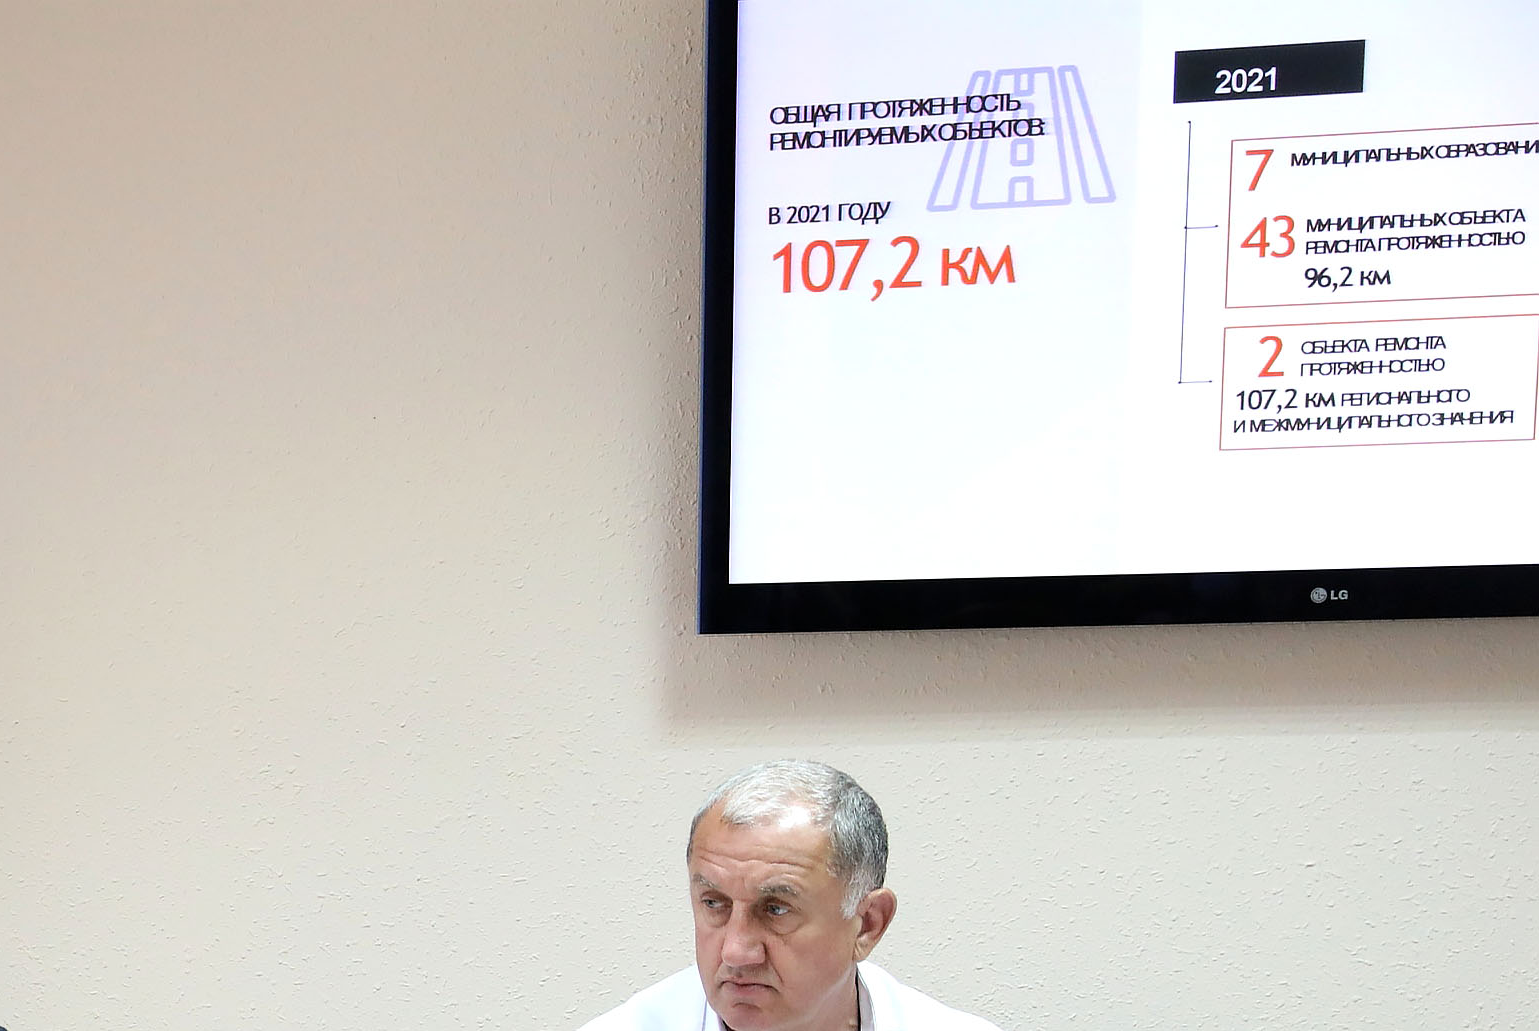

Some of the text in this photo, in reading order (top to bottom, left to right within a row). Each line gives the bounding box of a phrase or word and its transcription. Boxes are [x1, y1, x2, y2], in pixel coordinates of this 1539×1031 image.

[1214, 66, 1278, 94] 2021
[769, 93, 1022, 128] ОБЩАЯ ПРОТЯЖЕННОСТЬ
[769, 123, 937, 151] РЕМОНТИРУЕМЫХ
[1245, 148, 1275, 192] 7
[1290, 146, 1435, 168] МУНИЦИПАЛЬНЫХ
[768, 201, 891, 225] В 2021 ГОДУ
[1306, 208, 1526, 234] МУНИЦИПАЛЬНЫХ ОБЪЕКТА
[1240, 214, 1296, 259] 43
[1305, 230, 1526, 256] РЕМОНТА ПРОТЯЖЕННОСТЬЮ
[772, 235, 923, 302] 107,2
[1304, 265, 1354, 292] 96,2
[1257, 335, 1285, 378] 2
[1300, 335, 1447, 355] ОБЪЕКТА РЕМОНТА
[1300, 358, 1446, 377] ПРОТЯЖЕННОСТЬЮ
[1235, 388, 1299, 414] 107,2
[1341, 389, 1471, 407] РЕГИОНАЛЬНОГО
[1233, 410, 1515, 434] И МЕЖМУНИЦИПАЛЬНОГО ЗНАЧЕНИЯ
[1330, 589, 1349, 601] LG
